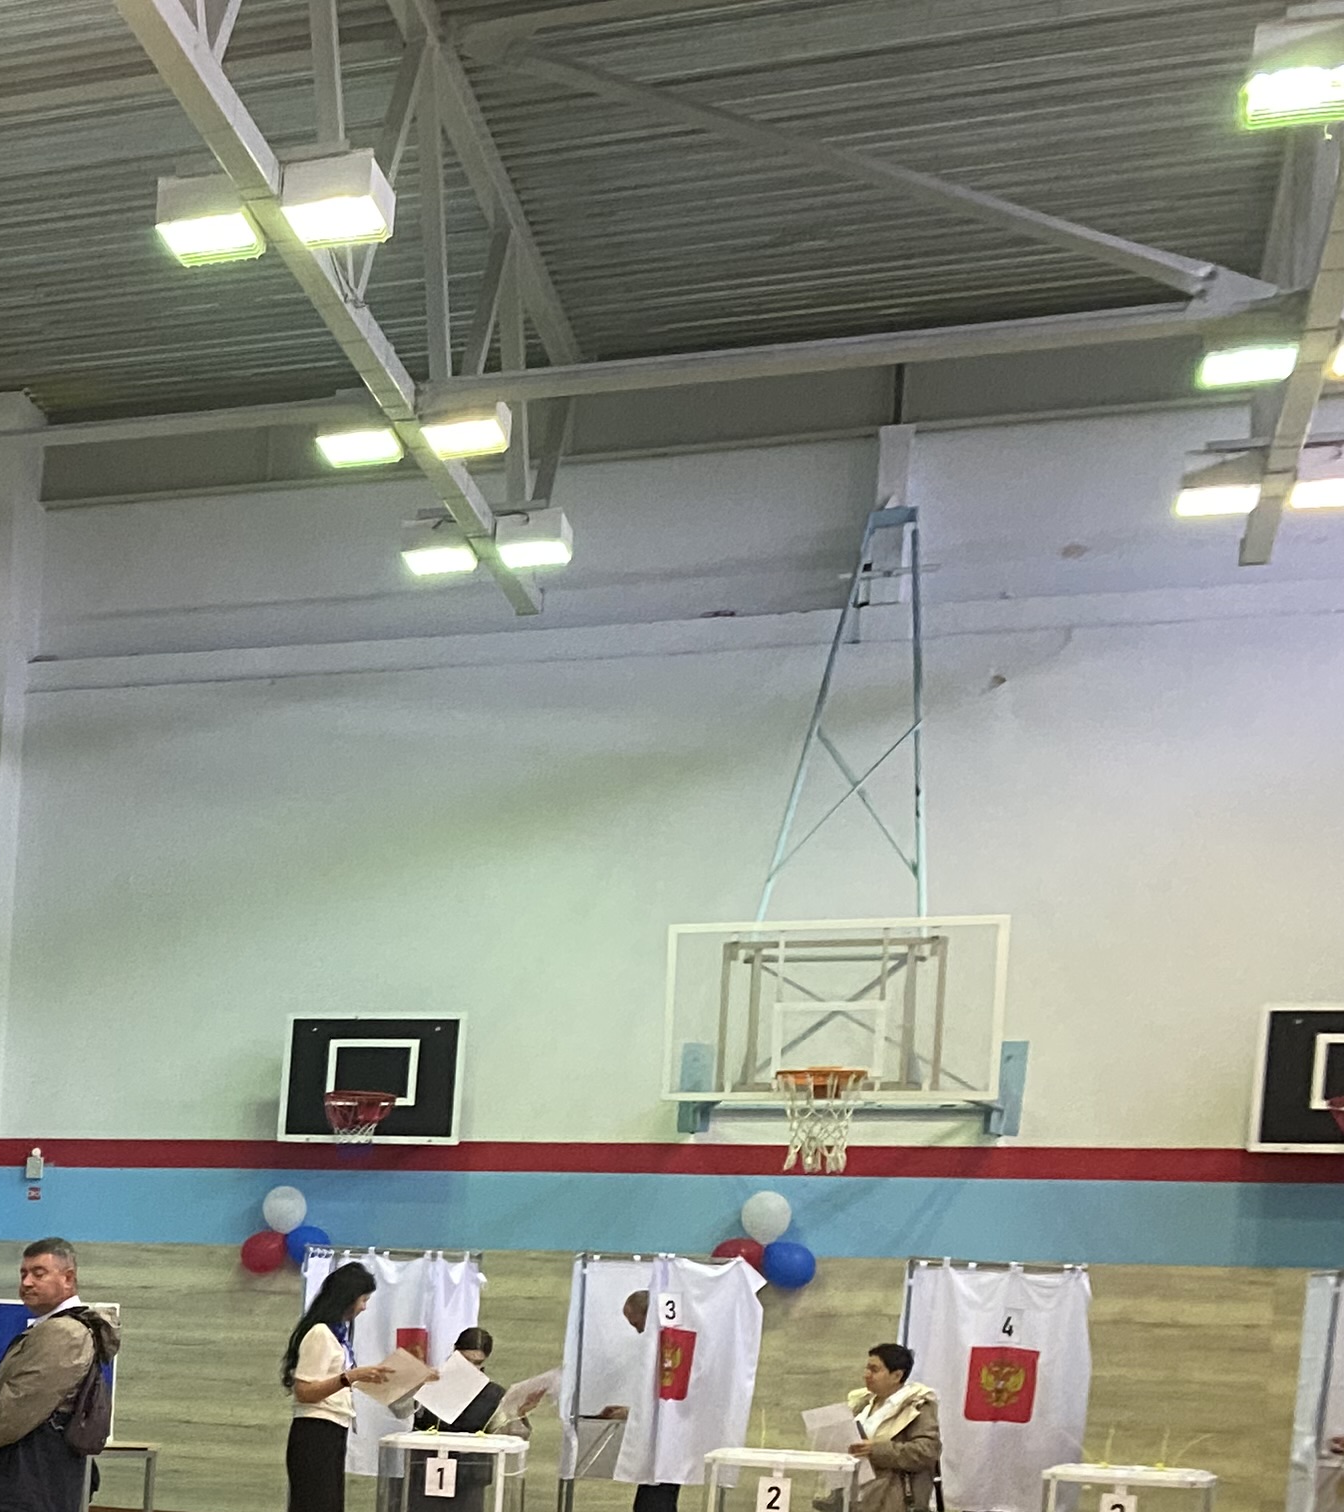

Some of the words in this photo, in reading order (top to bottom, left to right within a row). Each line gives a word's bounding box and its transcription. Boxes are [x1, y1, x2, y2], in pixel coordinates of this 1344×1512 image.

[665, 1300, 676, 1320] 3
[1002, 1316, 1013, 1337] 4
[436, 1467, 445, 1490] 1
[766, 1486, 782, 1511] 2
